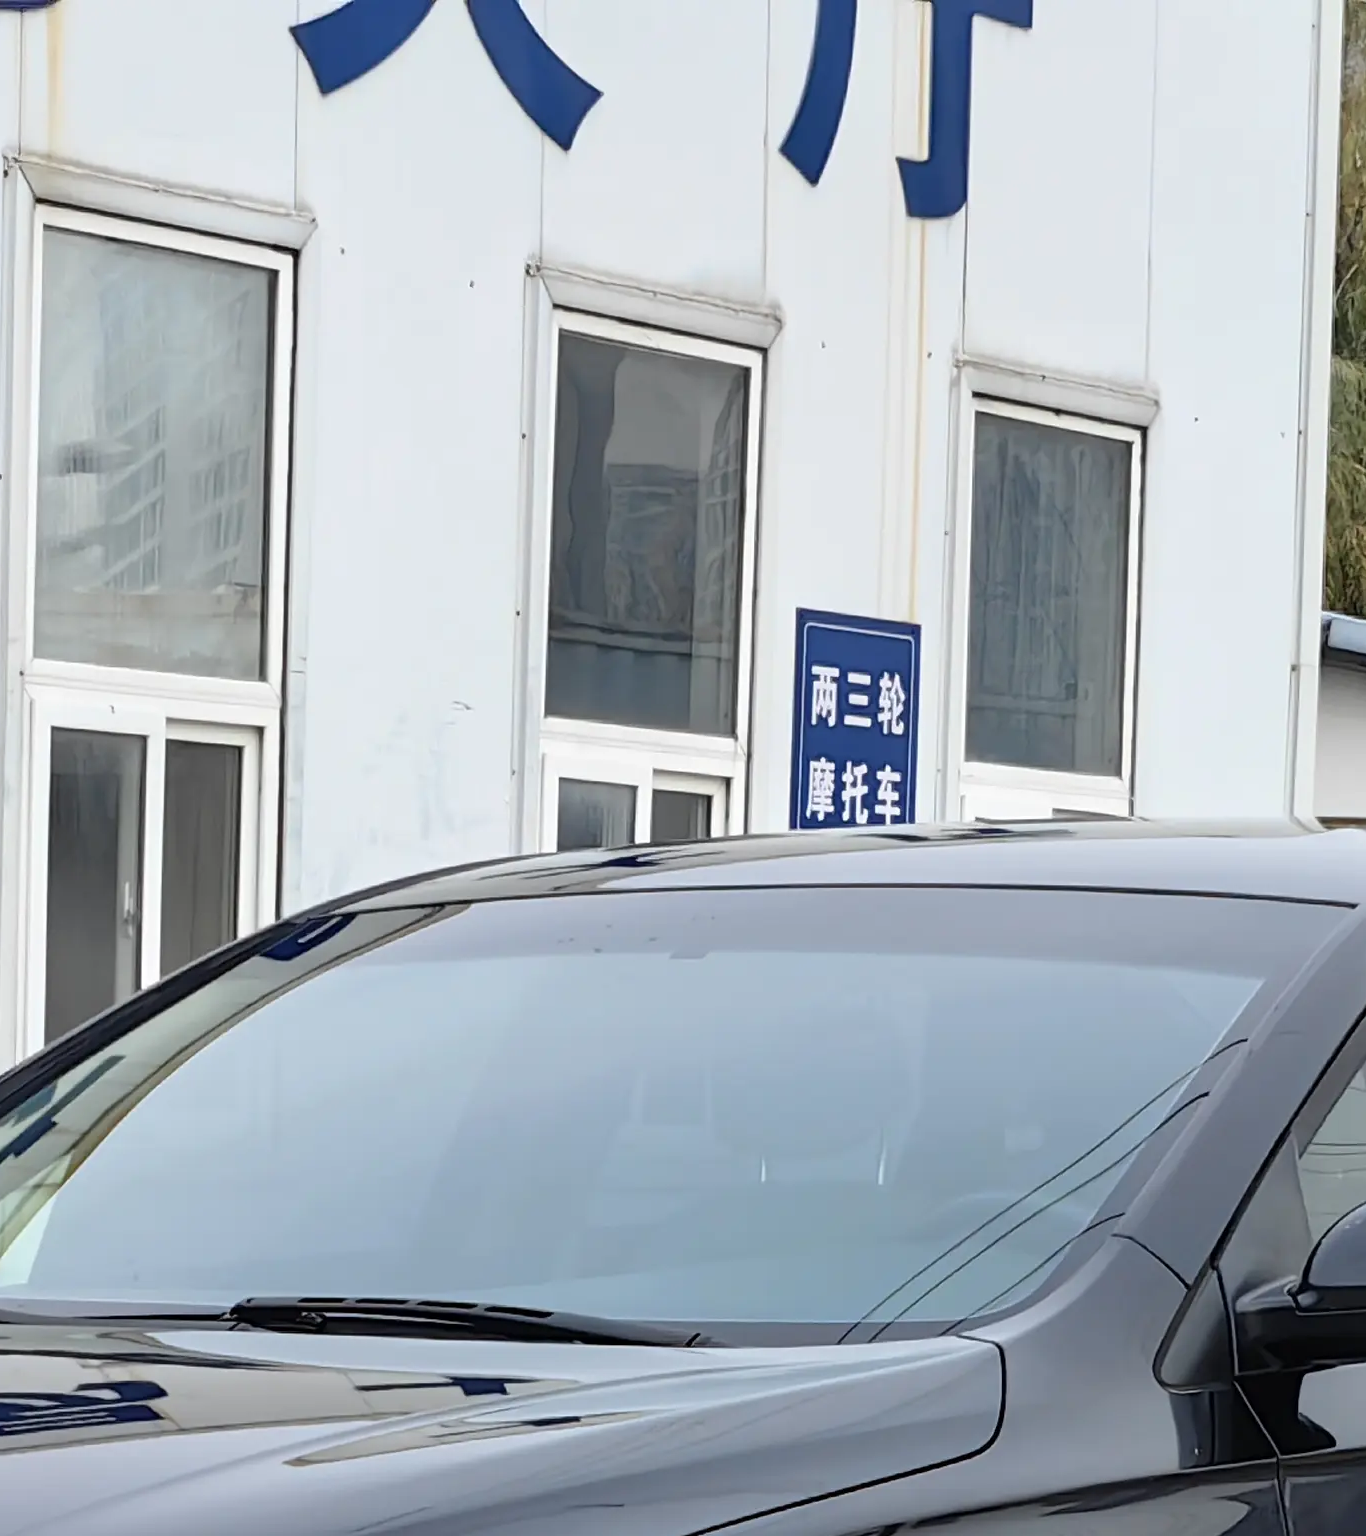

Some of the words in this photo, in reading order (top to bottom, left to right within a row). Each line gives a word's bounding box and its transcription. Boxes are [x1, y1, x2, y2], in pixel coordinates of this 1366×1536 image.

[810, 665, 906, 735] 两三轮
[806, 757, 902, 825] 摩托车
